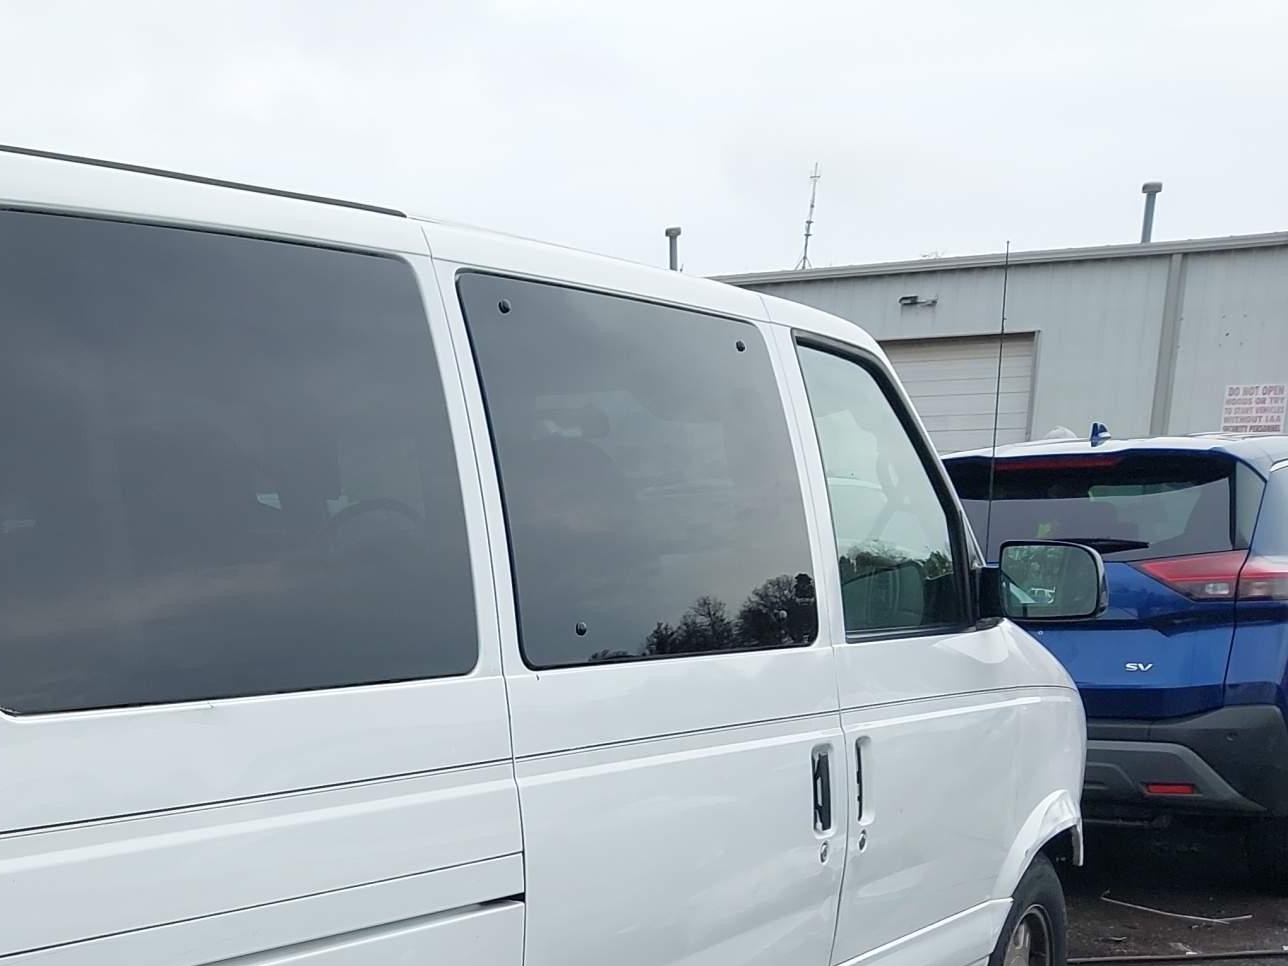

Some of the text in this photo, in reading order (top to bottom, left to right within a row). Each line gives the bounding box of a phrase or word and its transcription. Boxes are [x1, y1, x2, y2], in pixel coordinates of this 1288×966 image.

[1228, 385, 1285, 396] DO NOT OPEN
[1125, 663, 1153, 671] SV
